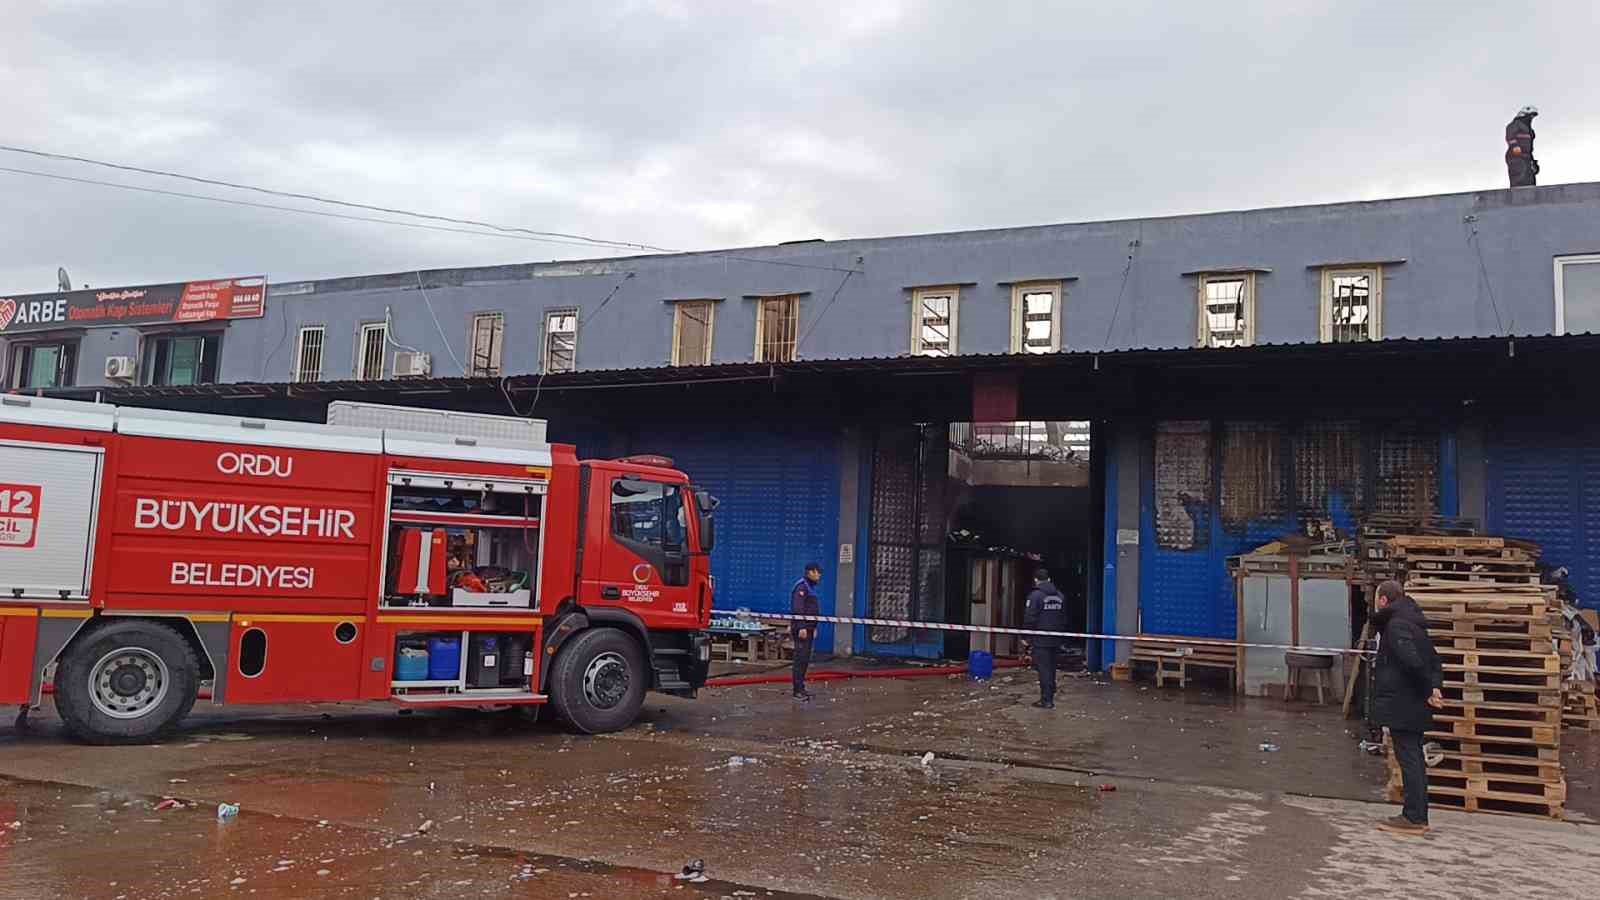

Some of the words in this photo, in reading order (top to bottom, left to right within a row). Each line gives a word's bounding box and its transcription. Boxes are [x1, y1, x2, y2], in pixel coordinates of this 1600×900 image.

[14, 299, 67, 324] ARBE
[217, 452, 293, 478] ORDU
[135, 498, 355, 538] BÜYÜKŞEHİR
